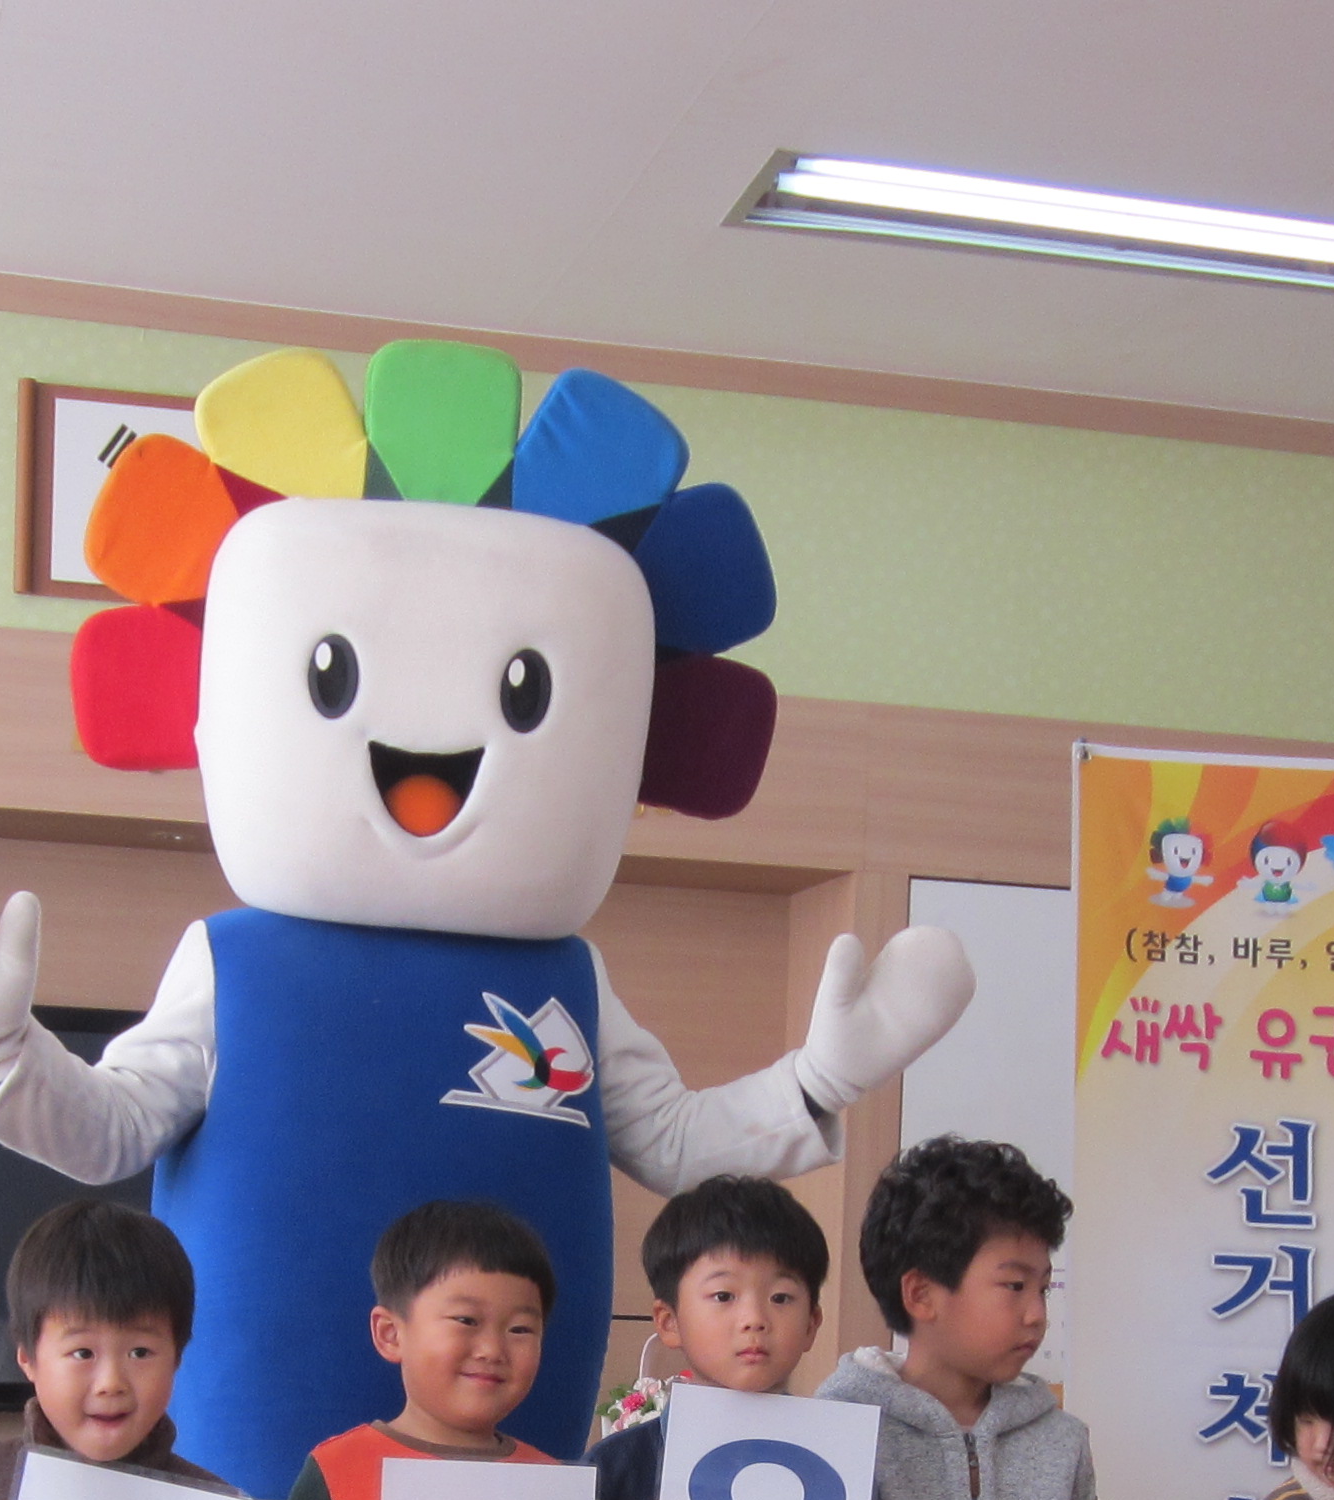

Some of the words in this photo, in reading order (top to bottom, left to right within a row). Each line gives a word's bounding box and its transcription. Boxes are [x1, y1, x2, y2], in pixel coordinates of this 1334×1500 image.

[1125, 928, 1216, 966] (참참,
[1232, 936, 1308, 970] 바루,
[1101, 997, 1223, 1071] 새싹
